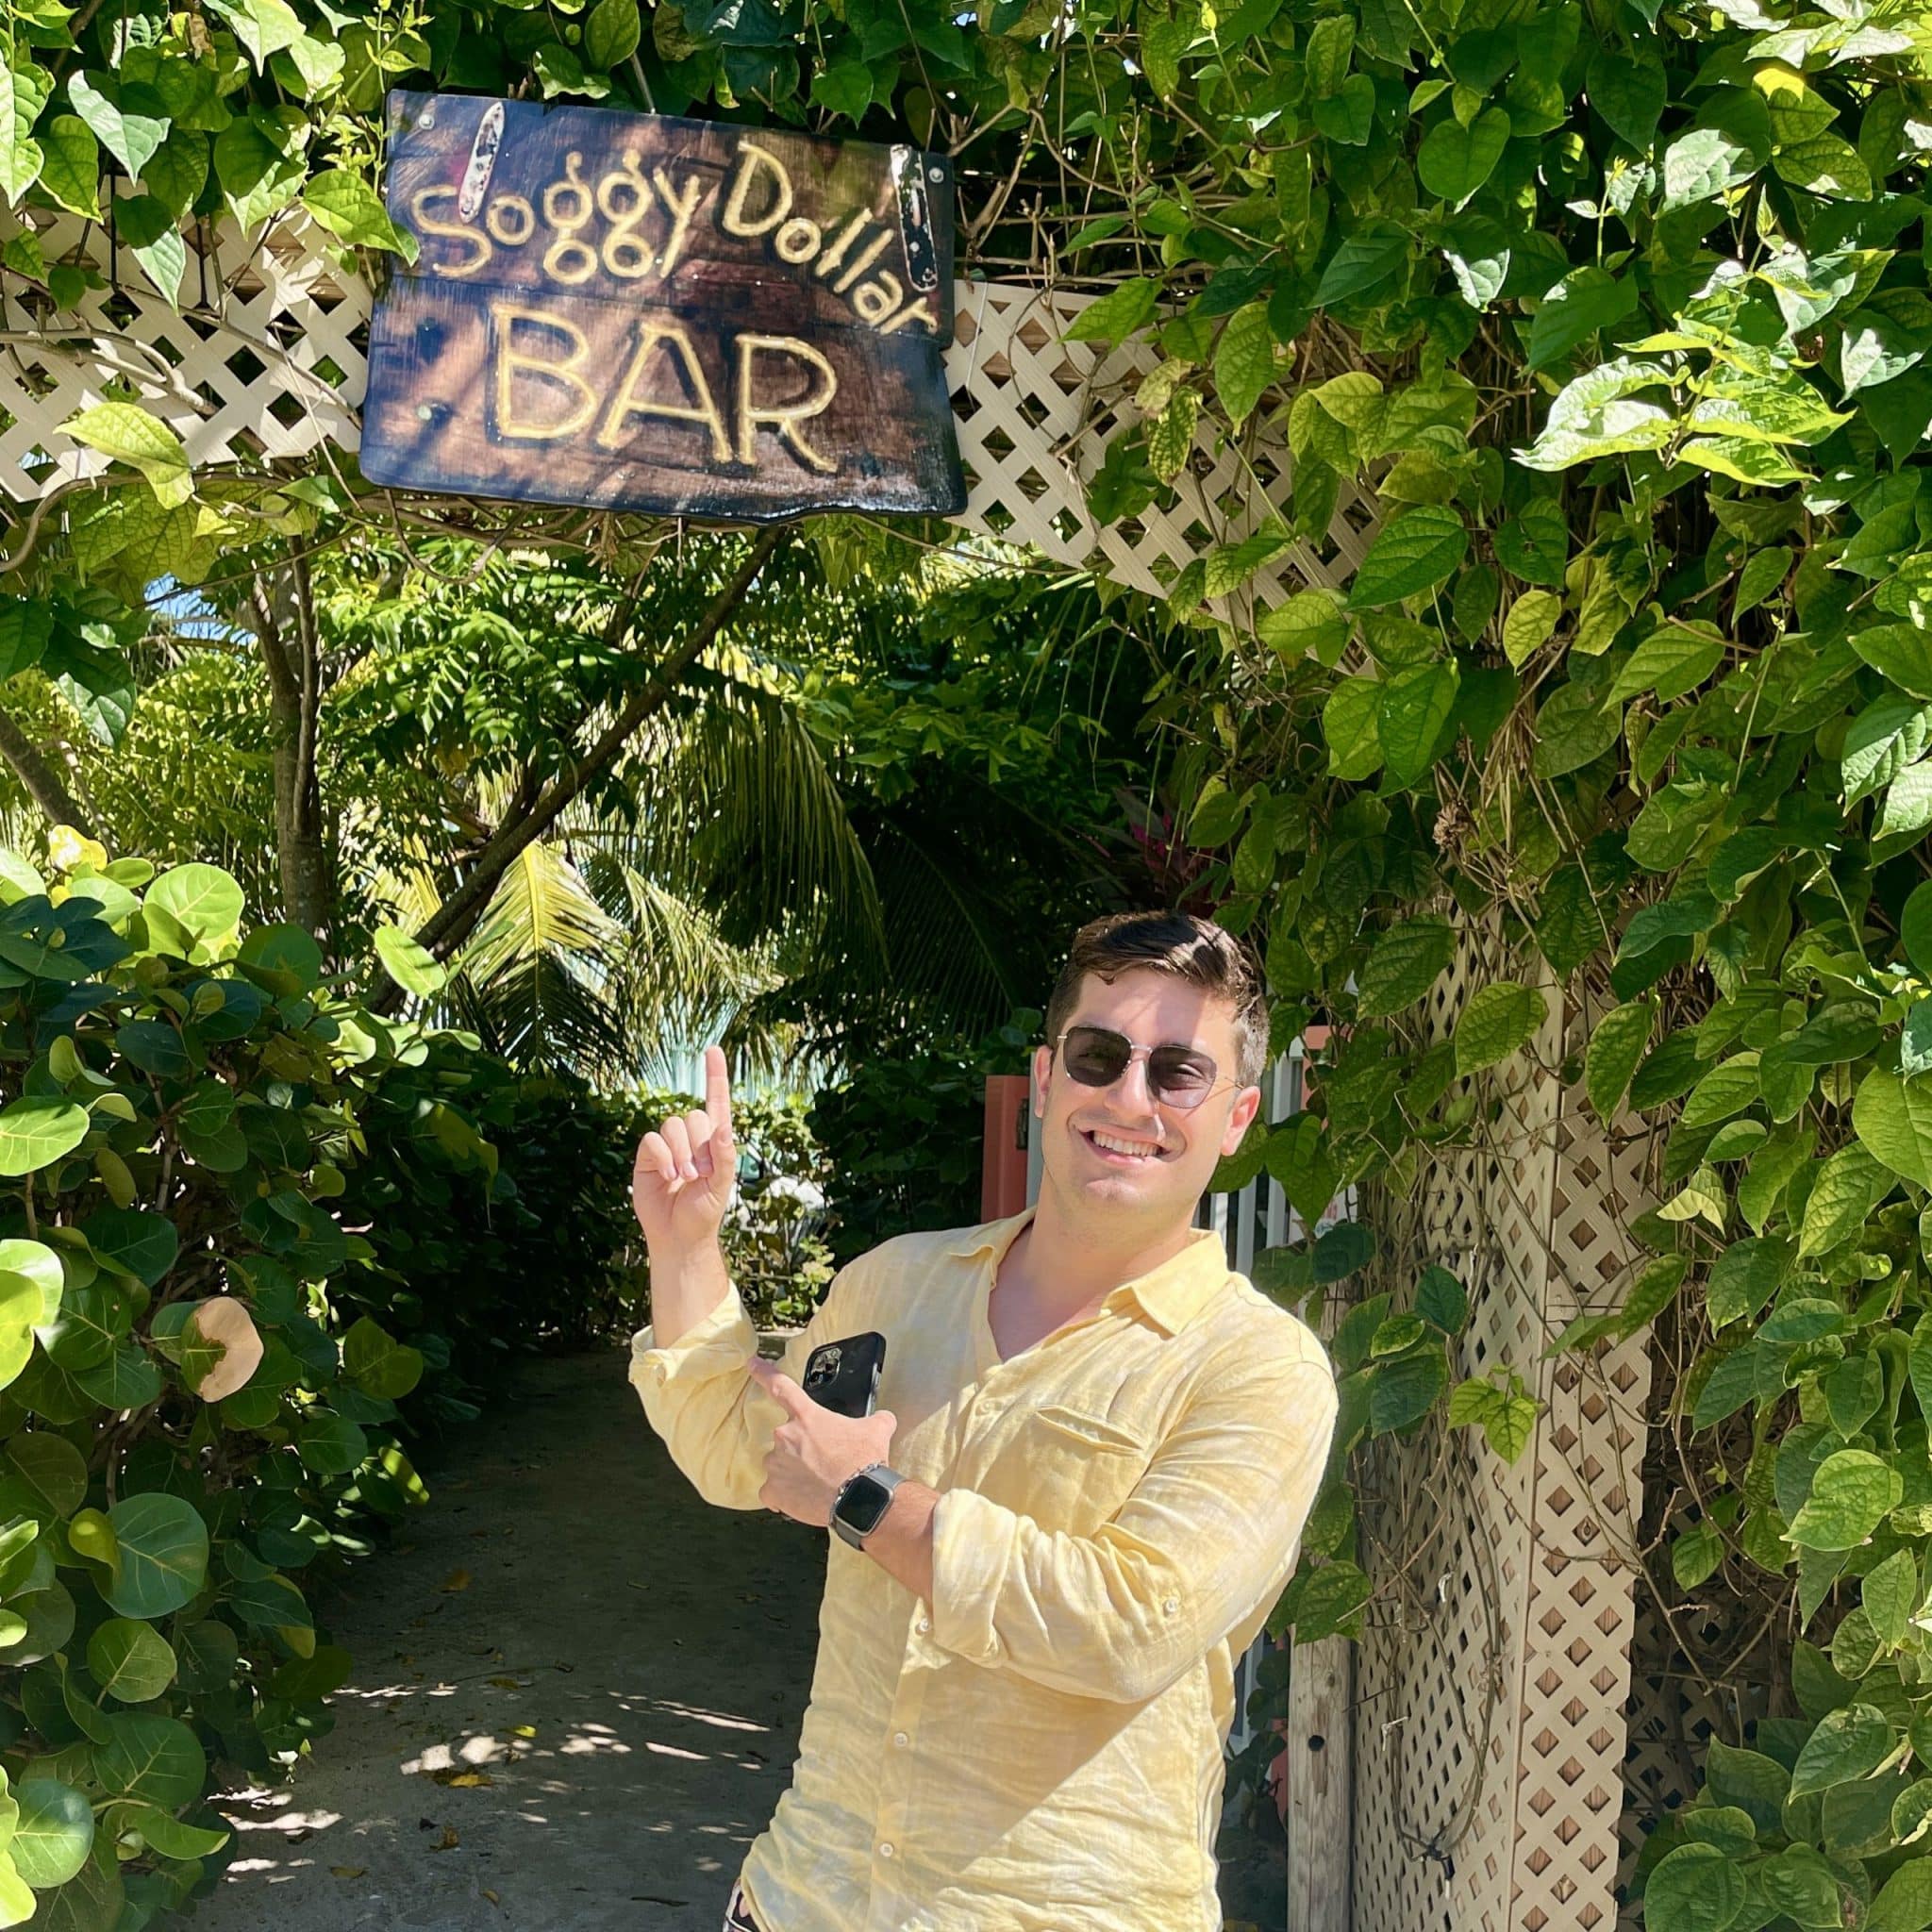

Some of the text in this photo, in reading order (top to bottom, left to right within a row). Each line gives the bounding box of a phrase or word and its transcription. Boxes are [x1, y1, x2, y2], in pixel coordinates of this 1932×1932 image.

[411, 140, 939, 335] Soggy Dollar
[491, 303, 838, 472] BAR
